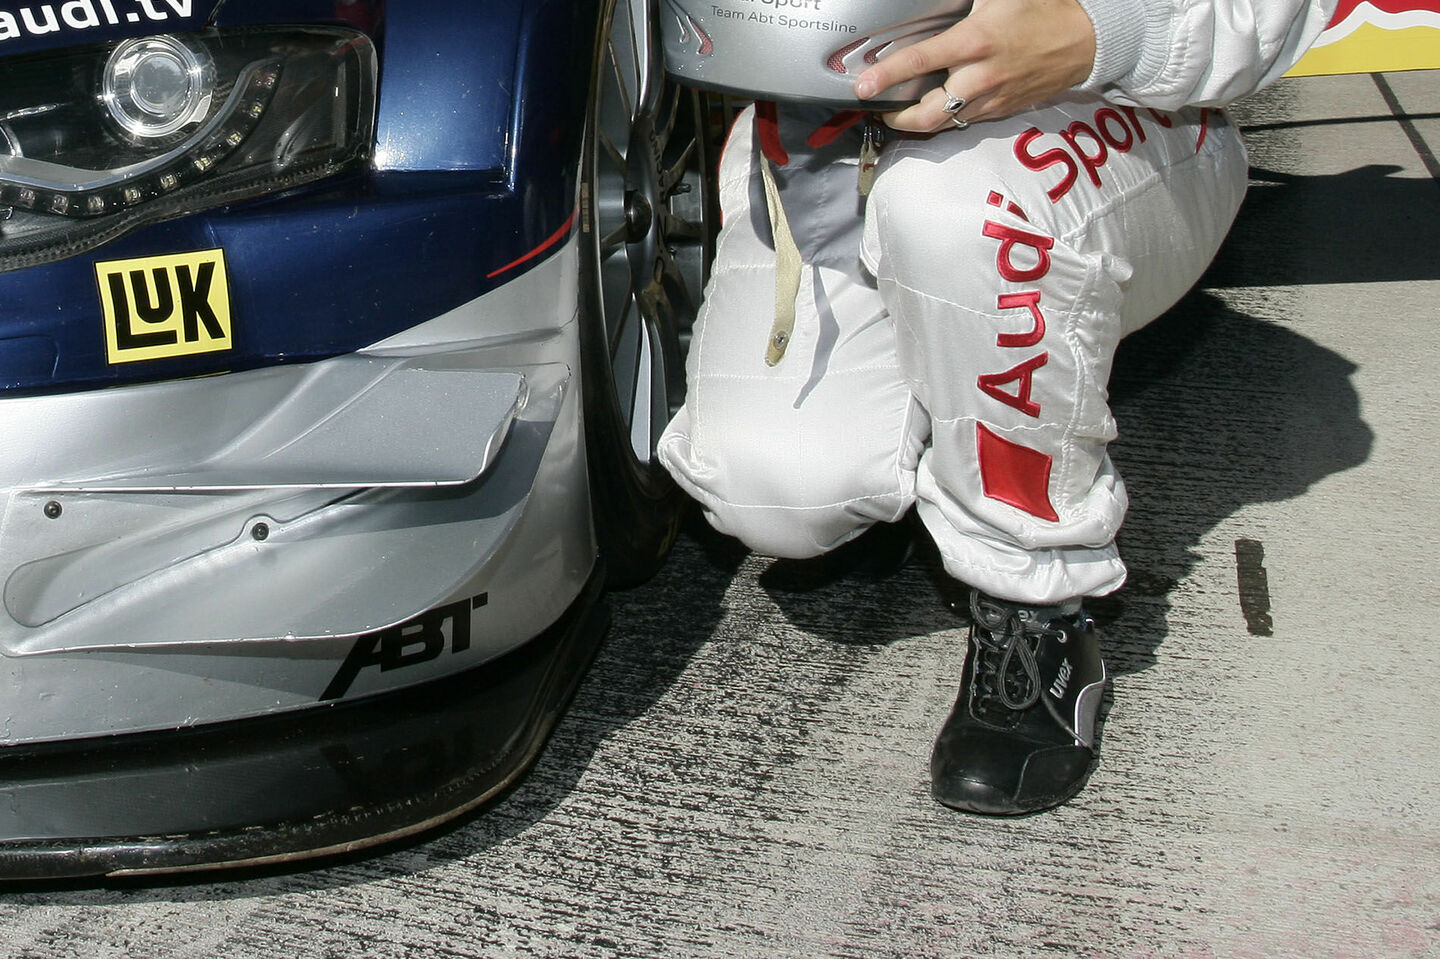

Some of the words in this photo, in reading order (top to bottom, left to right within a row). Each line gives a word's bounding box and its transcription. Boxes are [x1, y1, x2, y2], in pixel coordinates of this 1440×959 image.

[711, 5, 746, 21] Team
[748, 10, 774, 25] Abt
[777, 15, 858, 35] Sportsline
[977, 190, 1055, 419] Audi
[318, 592, 489, 702] ABT
[1050, 658, 1073, 699] uvex
